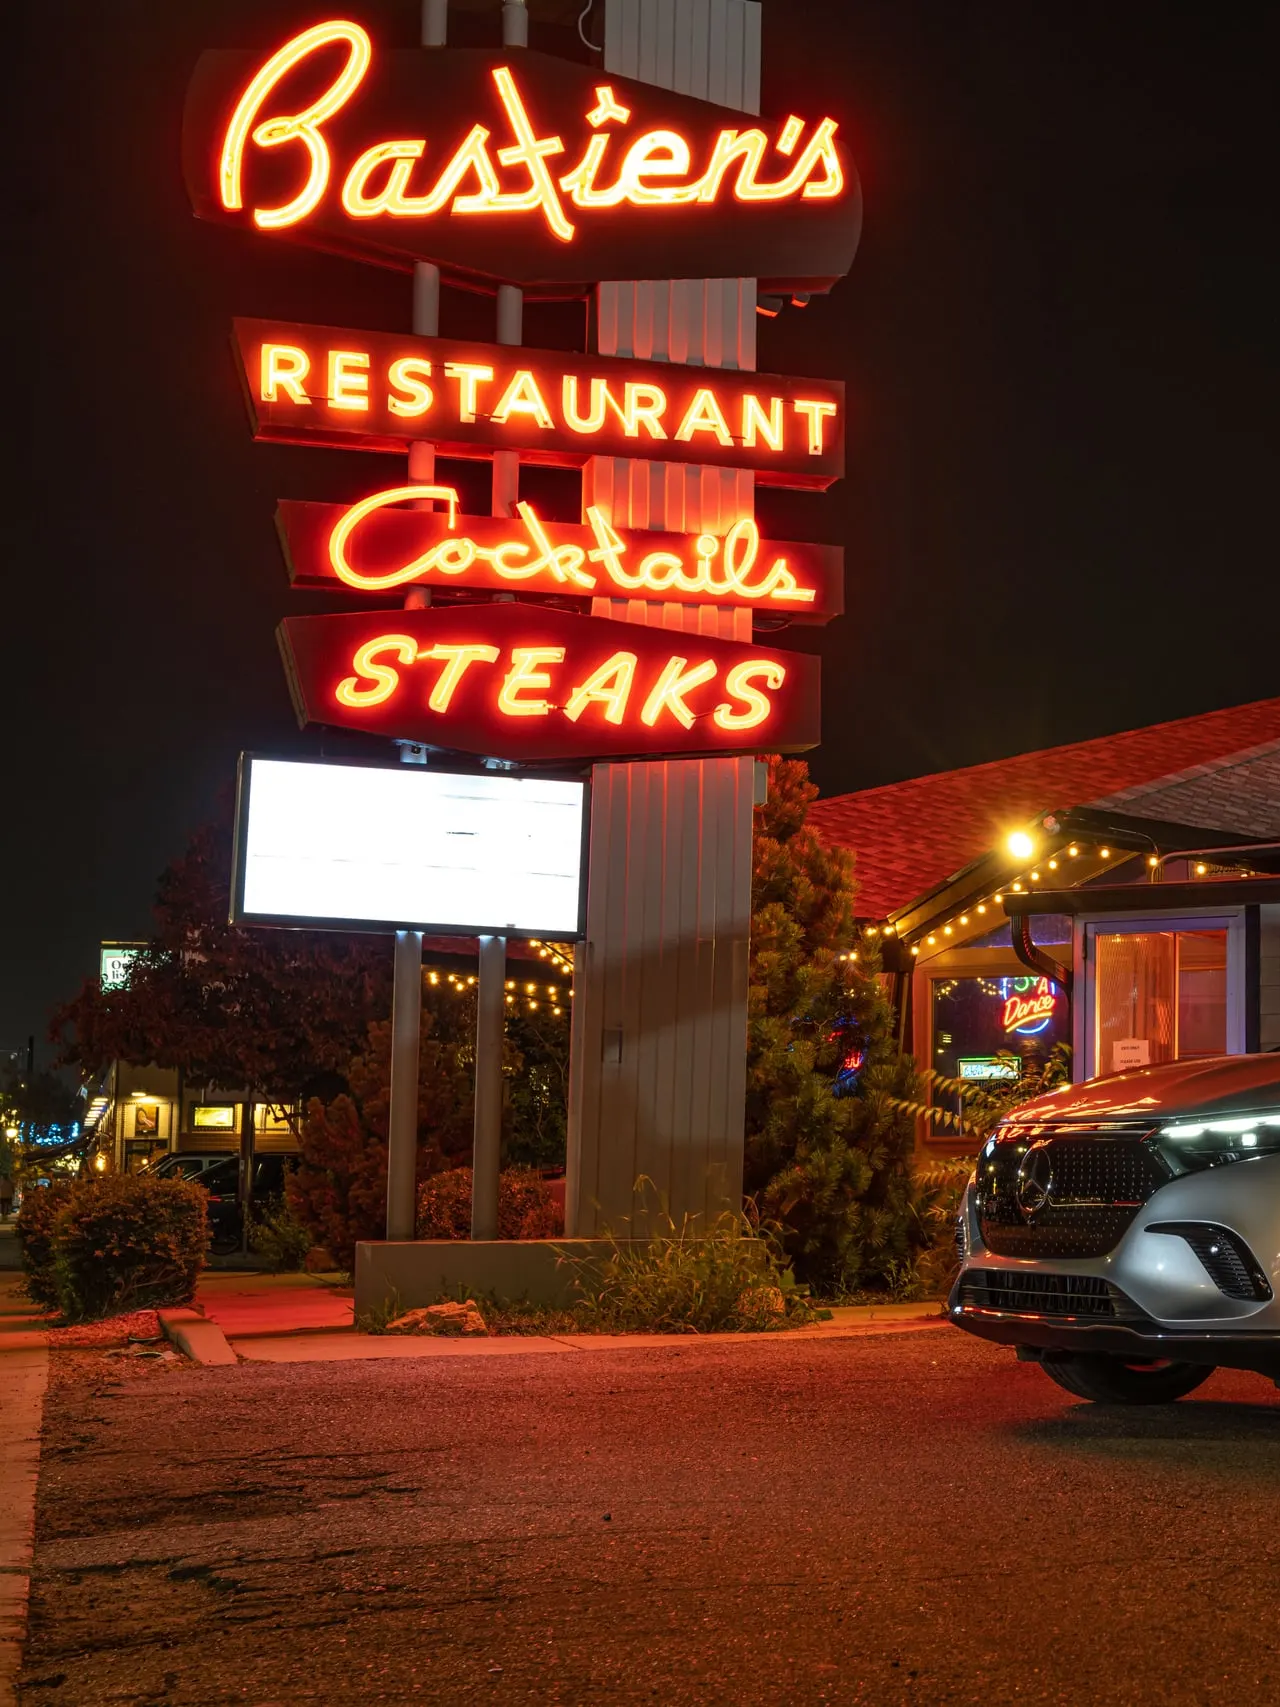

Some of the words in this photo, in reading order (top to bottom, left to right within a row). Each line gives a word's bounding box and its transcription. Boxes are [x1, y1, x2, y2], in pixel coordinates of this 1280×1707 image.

[218, 20, 846, 242] Bastien's
[260, 342, 838, 457] RESTAURANT
[328, 485, 816, 602] Cocktails
[334, 633, 787, 732] STEAKS
[1003, 995, 1056, 1026] Dance
